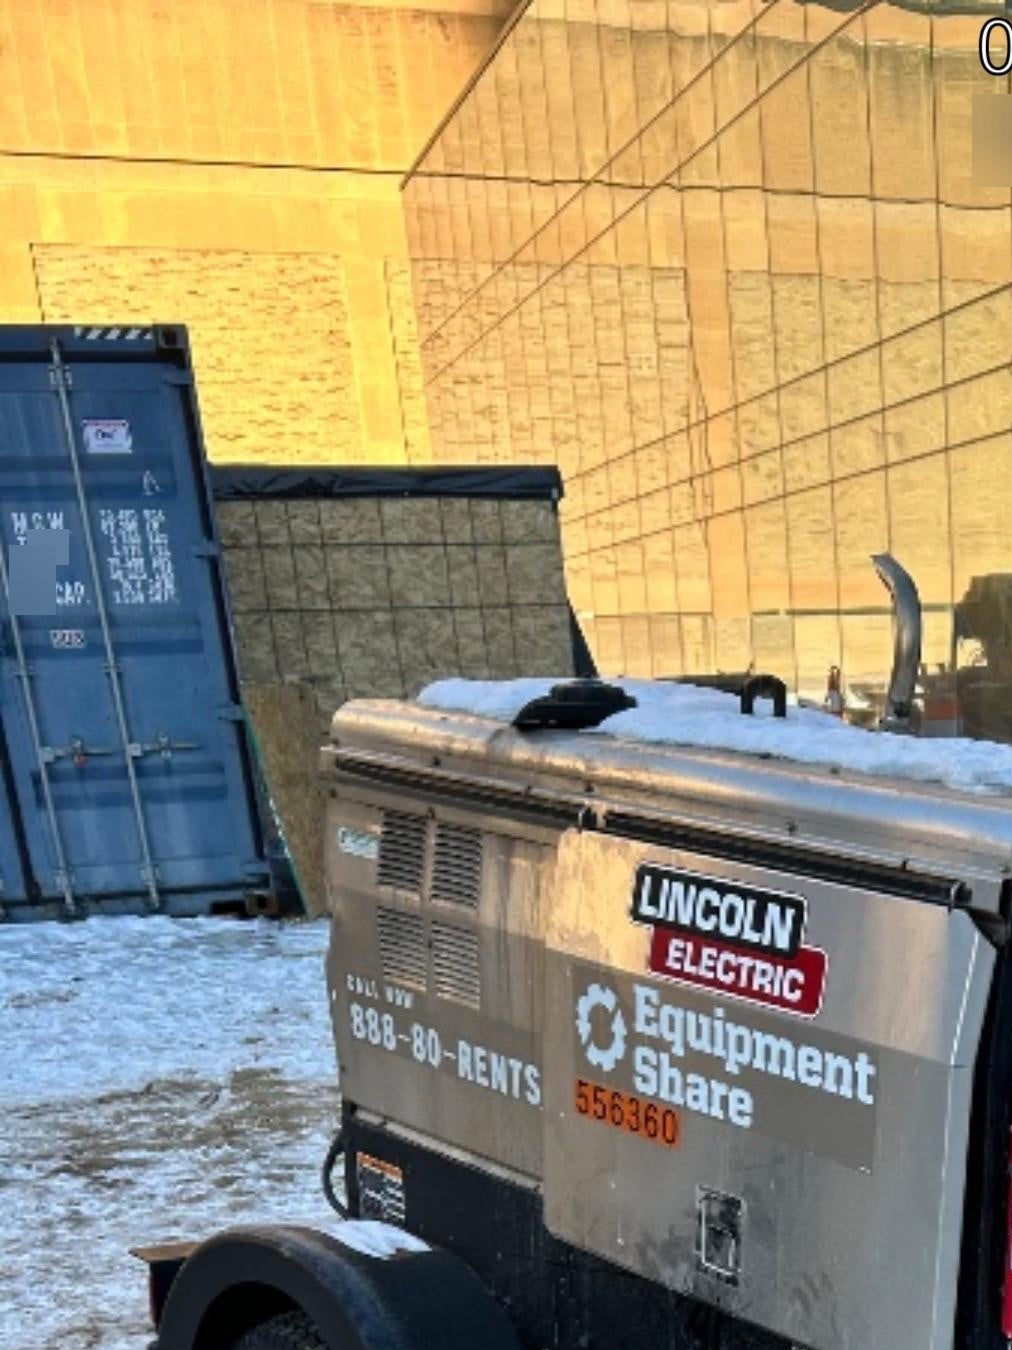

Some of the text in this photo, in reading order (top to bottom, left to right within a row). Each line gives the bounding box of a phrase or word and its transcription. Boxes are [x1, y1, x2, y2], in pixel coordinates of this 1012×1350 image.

[637, 874, 796, 950] LINCOLN
[665, 938, 805, 1002] ELECTRIC
[350, 1001, 542, 1105] 888-80-RENTS
[633, 983, 876, 1105] Equipment
[575, 1079, 678, 1145] 556360
[633, 1046, 754, 1128] Share
